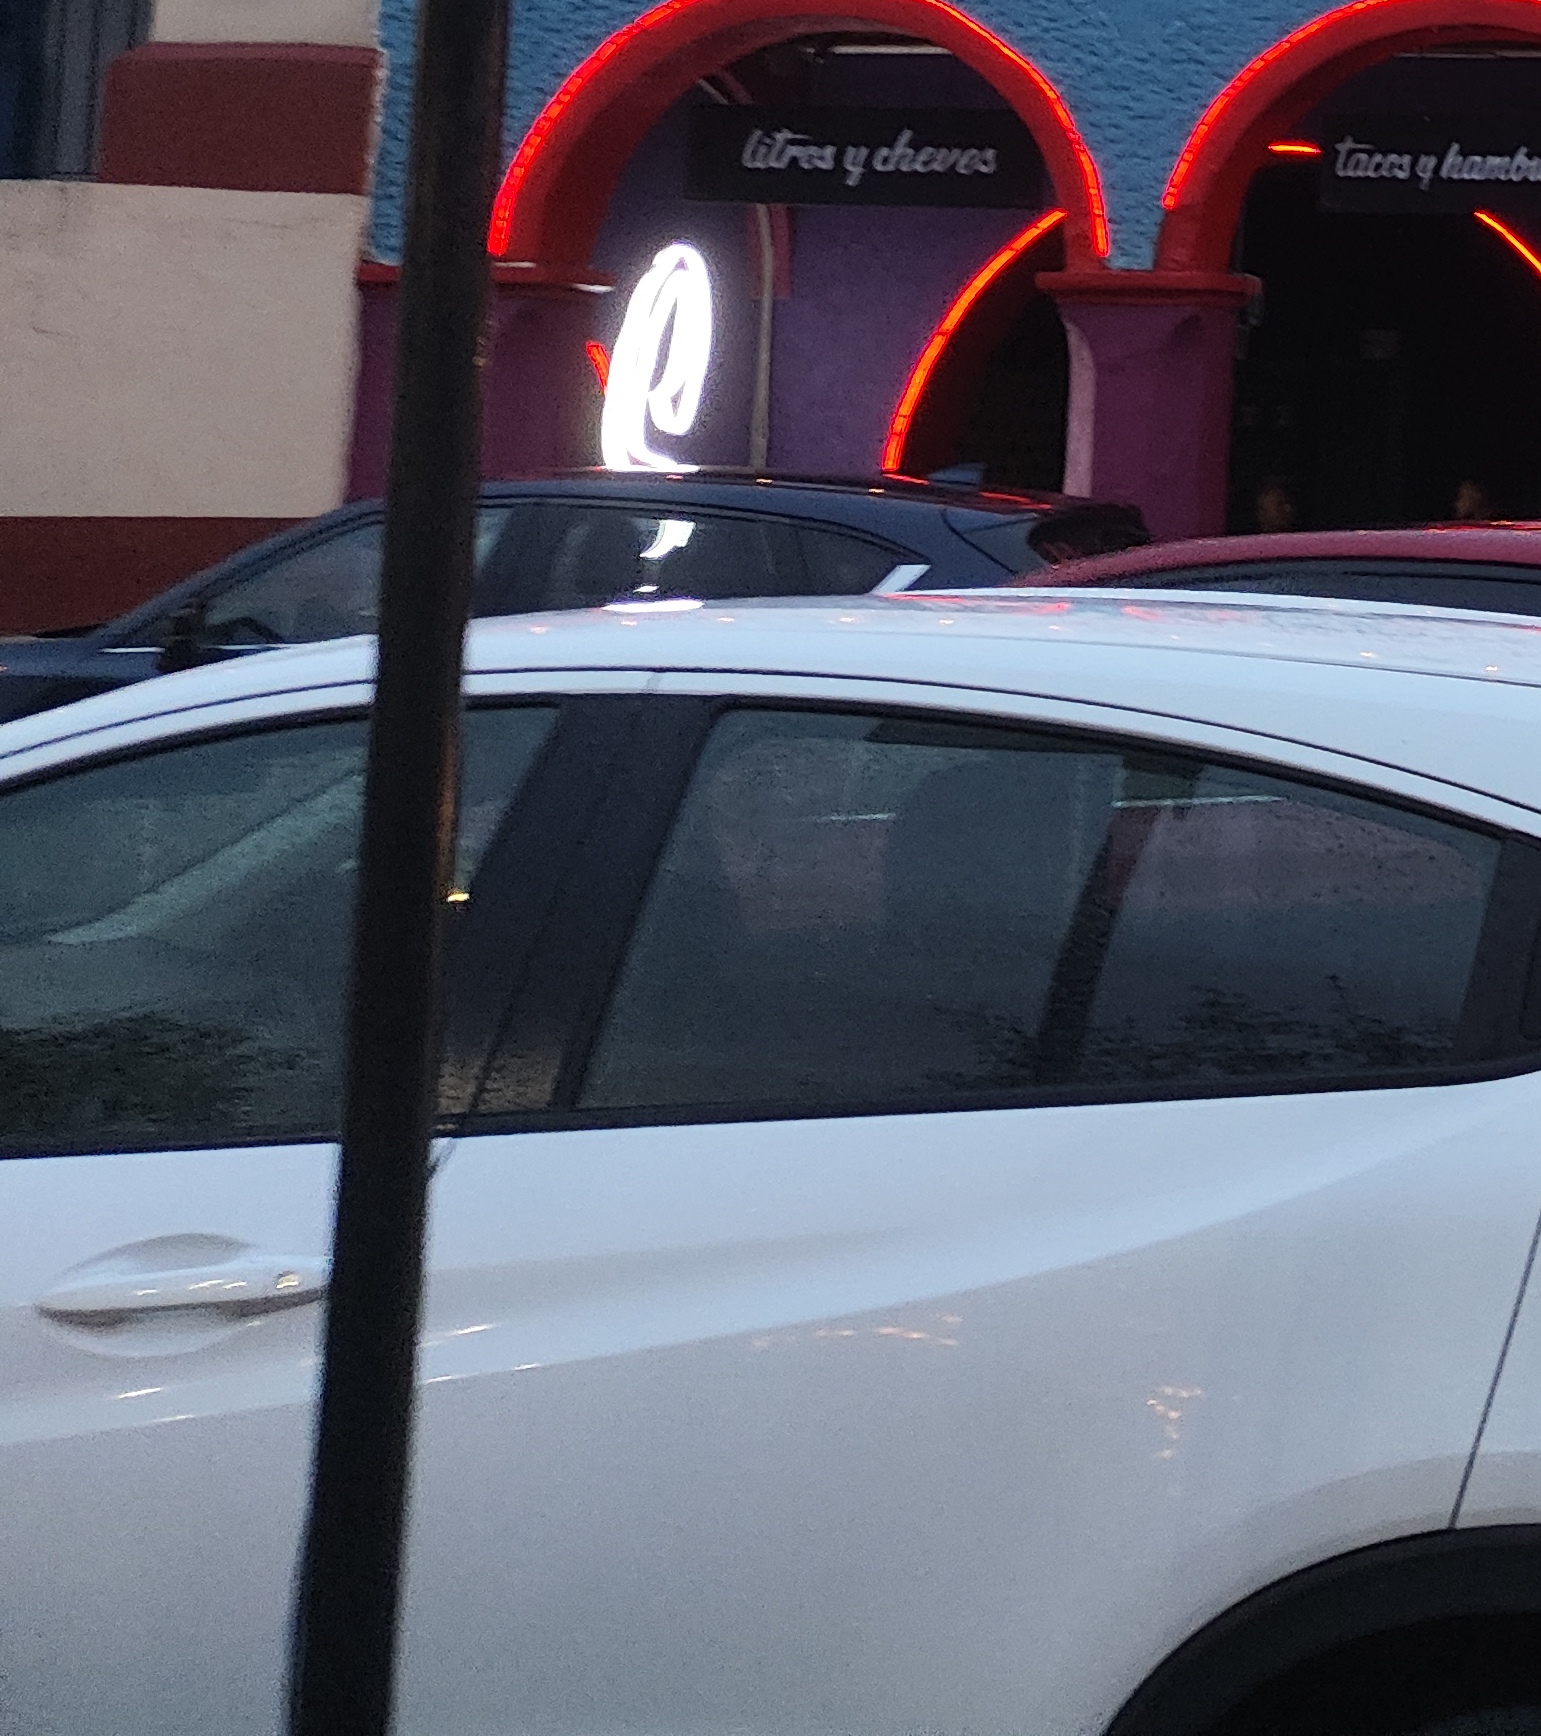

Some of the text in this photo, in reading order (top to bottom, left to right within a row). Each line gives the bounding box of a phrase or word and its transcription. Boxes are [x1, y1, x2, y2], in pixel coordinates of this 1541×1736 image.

[741, 127, 838, 169] litros
[843, 144, 871, 187] y
[1334, 134, 1412, 180] tacos
[1414, 153, 1439, 191] y
